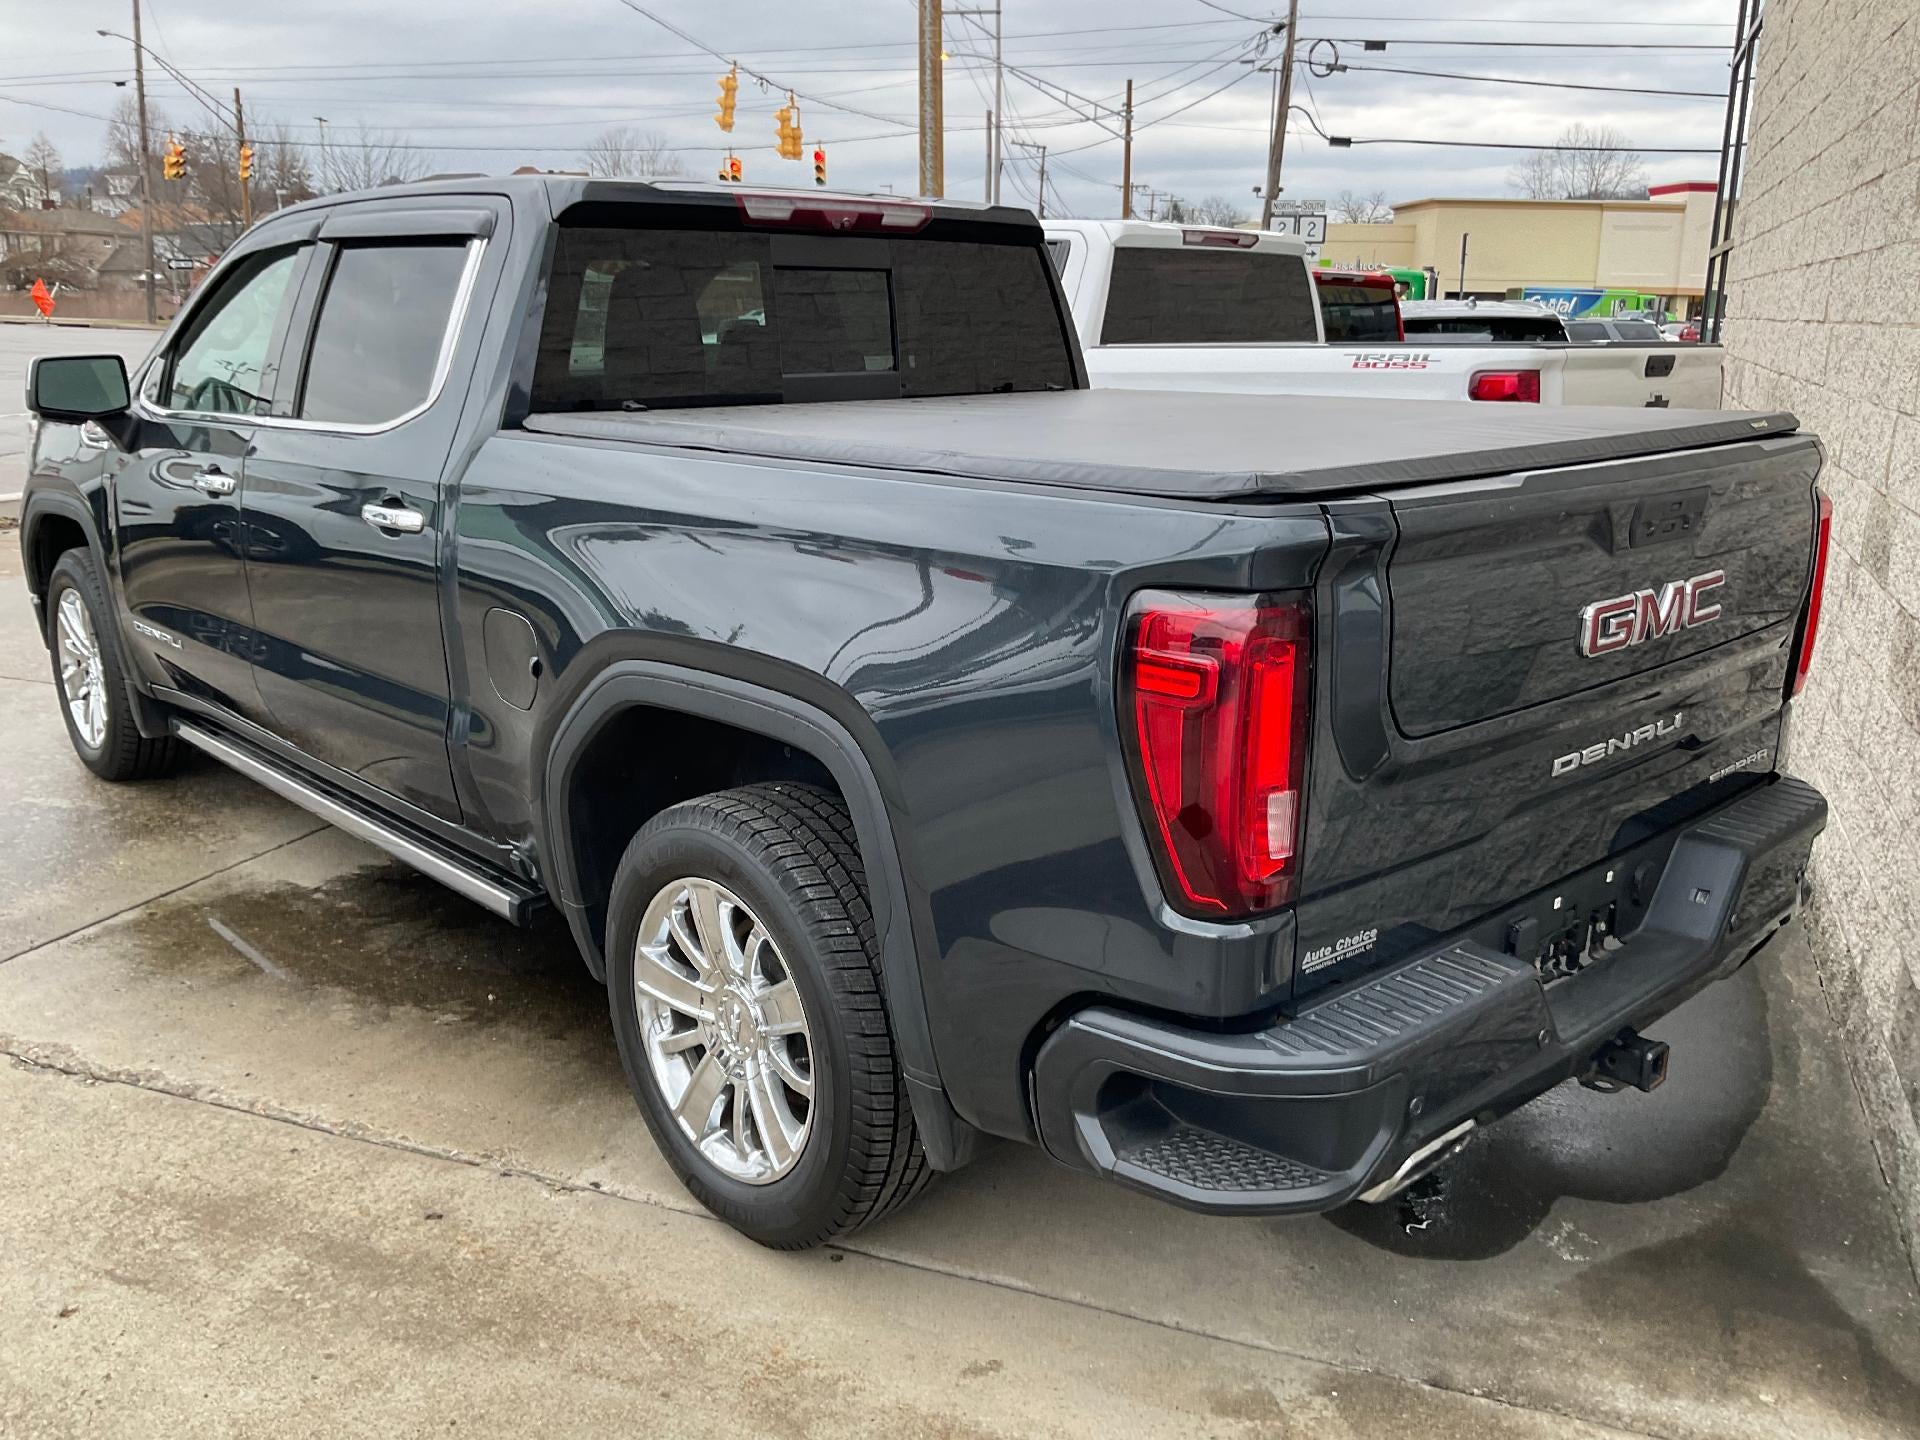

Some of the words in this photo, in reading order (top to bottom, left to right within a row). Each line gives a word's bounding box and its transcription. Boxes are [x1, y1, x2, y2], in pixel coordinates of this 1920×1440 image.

[1274, 202, 1294, 210] NORTH
[1303, 202, 1324, 210] SOUTH
[1307, 221, 1316, 237] 2
[1344, 353, 1441, 362] TRAIL
[1352, 361, 1428, 369] BOSS
[1580, 569, 1725, 658] GMC
[133, 621, 181, 648] DENALI
[1551, 712, 1682, 777] DENALI
[1302, 946, 1332, 965] Auto
[1335, 928, 1378, 951] Choice
